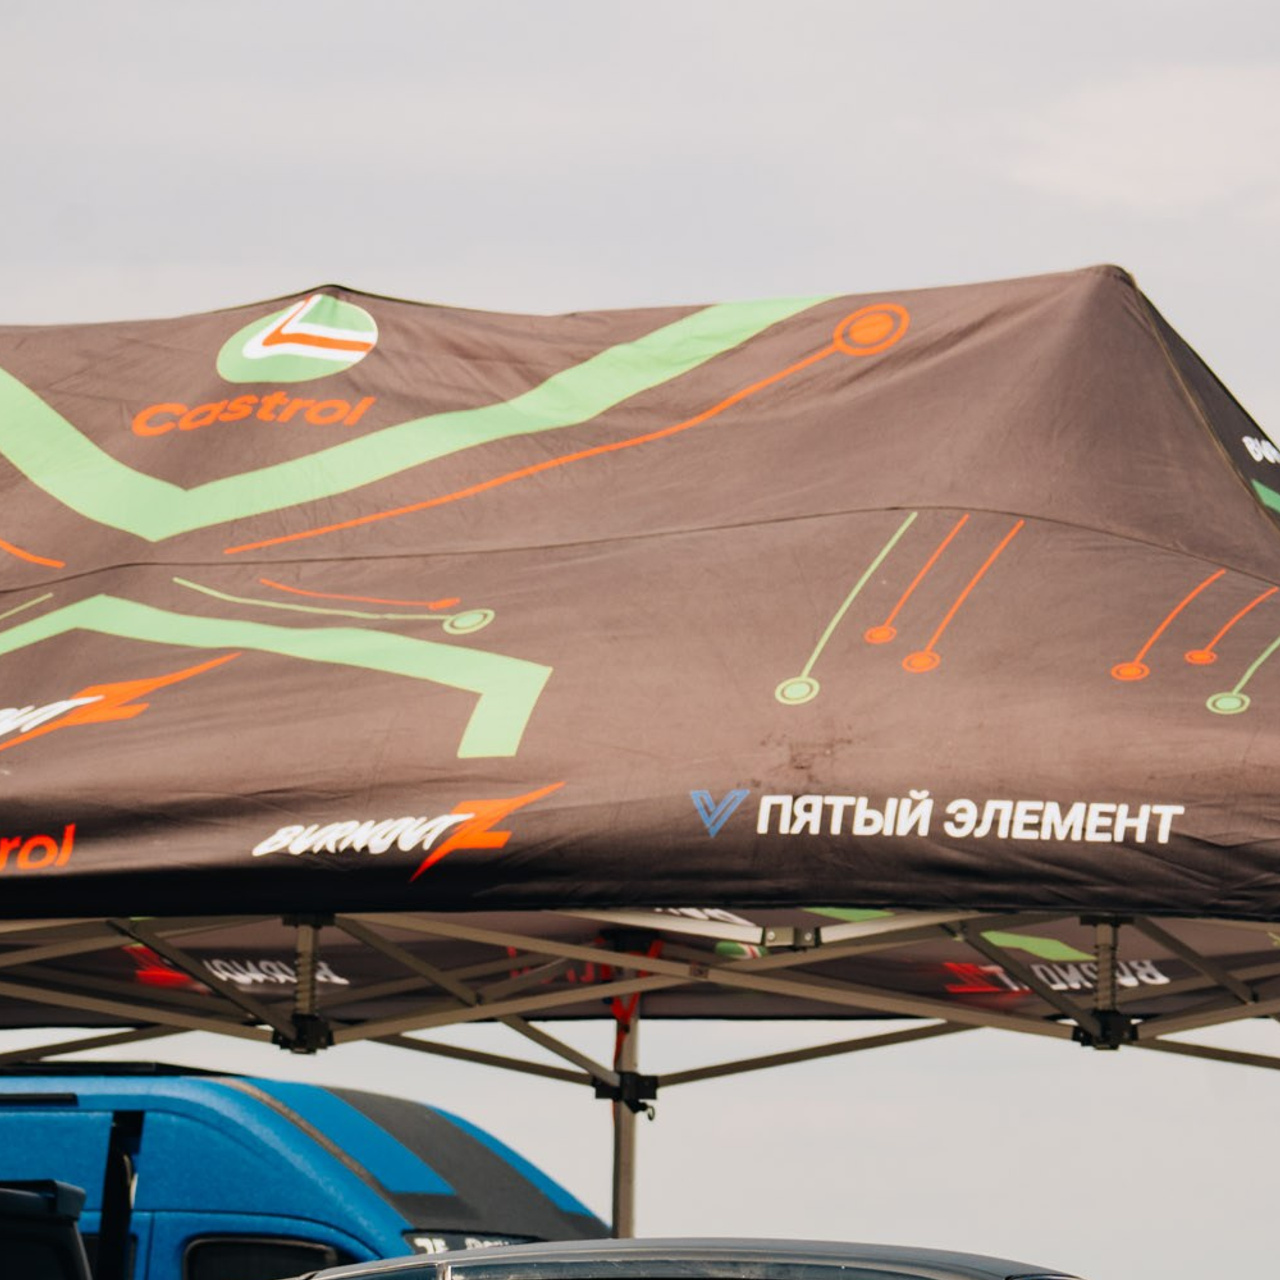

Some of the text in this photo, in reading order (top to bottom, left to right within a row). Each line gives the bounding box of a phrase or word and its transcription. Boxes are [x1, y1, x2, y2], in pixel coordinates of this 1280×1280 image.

[131, 391, 376, 437] Castrol
[757, 790, 1185, 844] ПЯТЫЙ ЭЛЕМЕНТ
